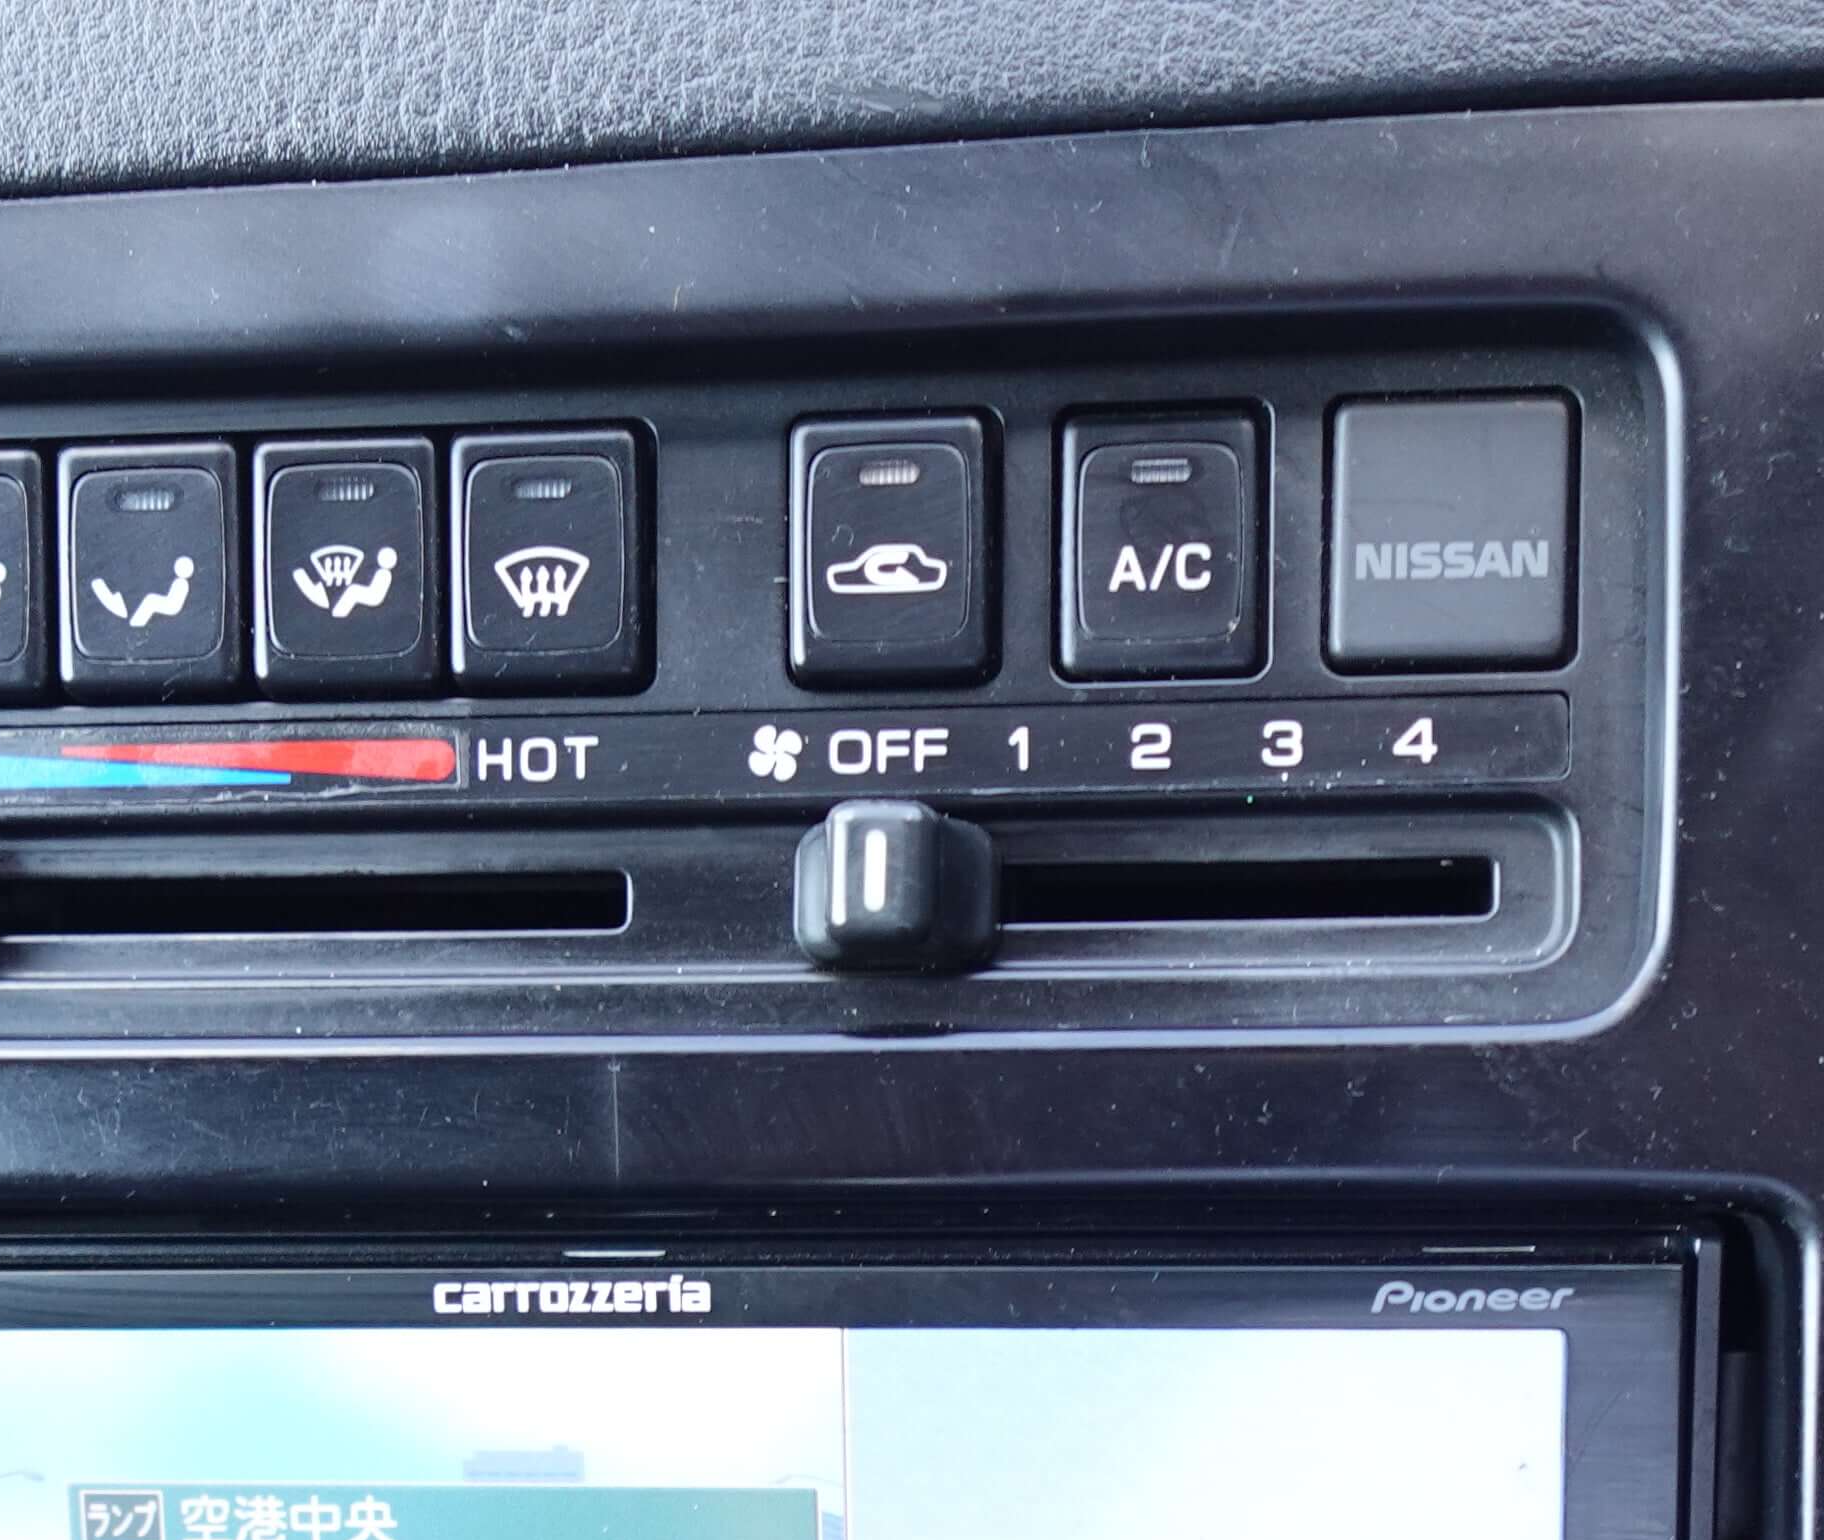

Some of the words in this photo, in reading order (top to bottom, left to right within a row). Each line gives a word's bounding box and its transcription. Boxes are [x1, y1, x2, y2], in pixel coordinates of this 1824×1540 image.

[1108, 542, 1212, 593] A/C
[1355, 541, 1549, 579] NISSAN
[478, 736, 600, 782] HOT
[828, 728, 949, 773] OFF
[1008, 728, 1031, 771] 1
[1129, 724, 1173, 770] 2
[1262, 719, 1304, 768] 3
[1393, 718, 1438, 763] 4
[433, 1274, 712, 1314] carrozzeria
[1371, 1280, 1575, 1313] Pioneer
[87, 1504, 159, 1536] ランプ
